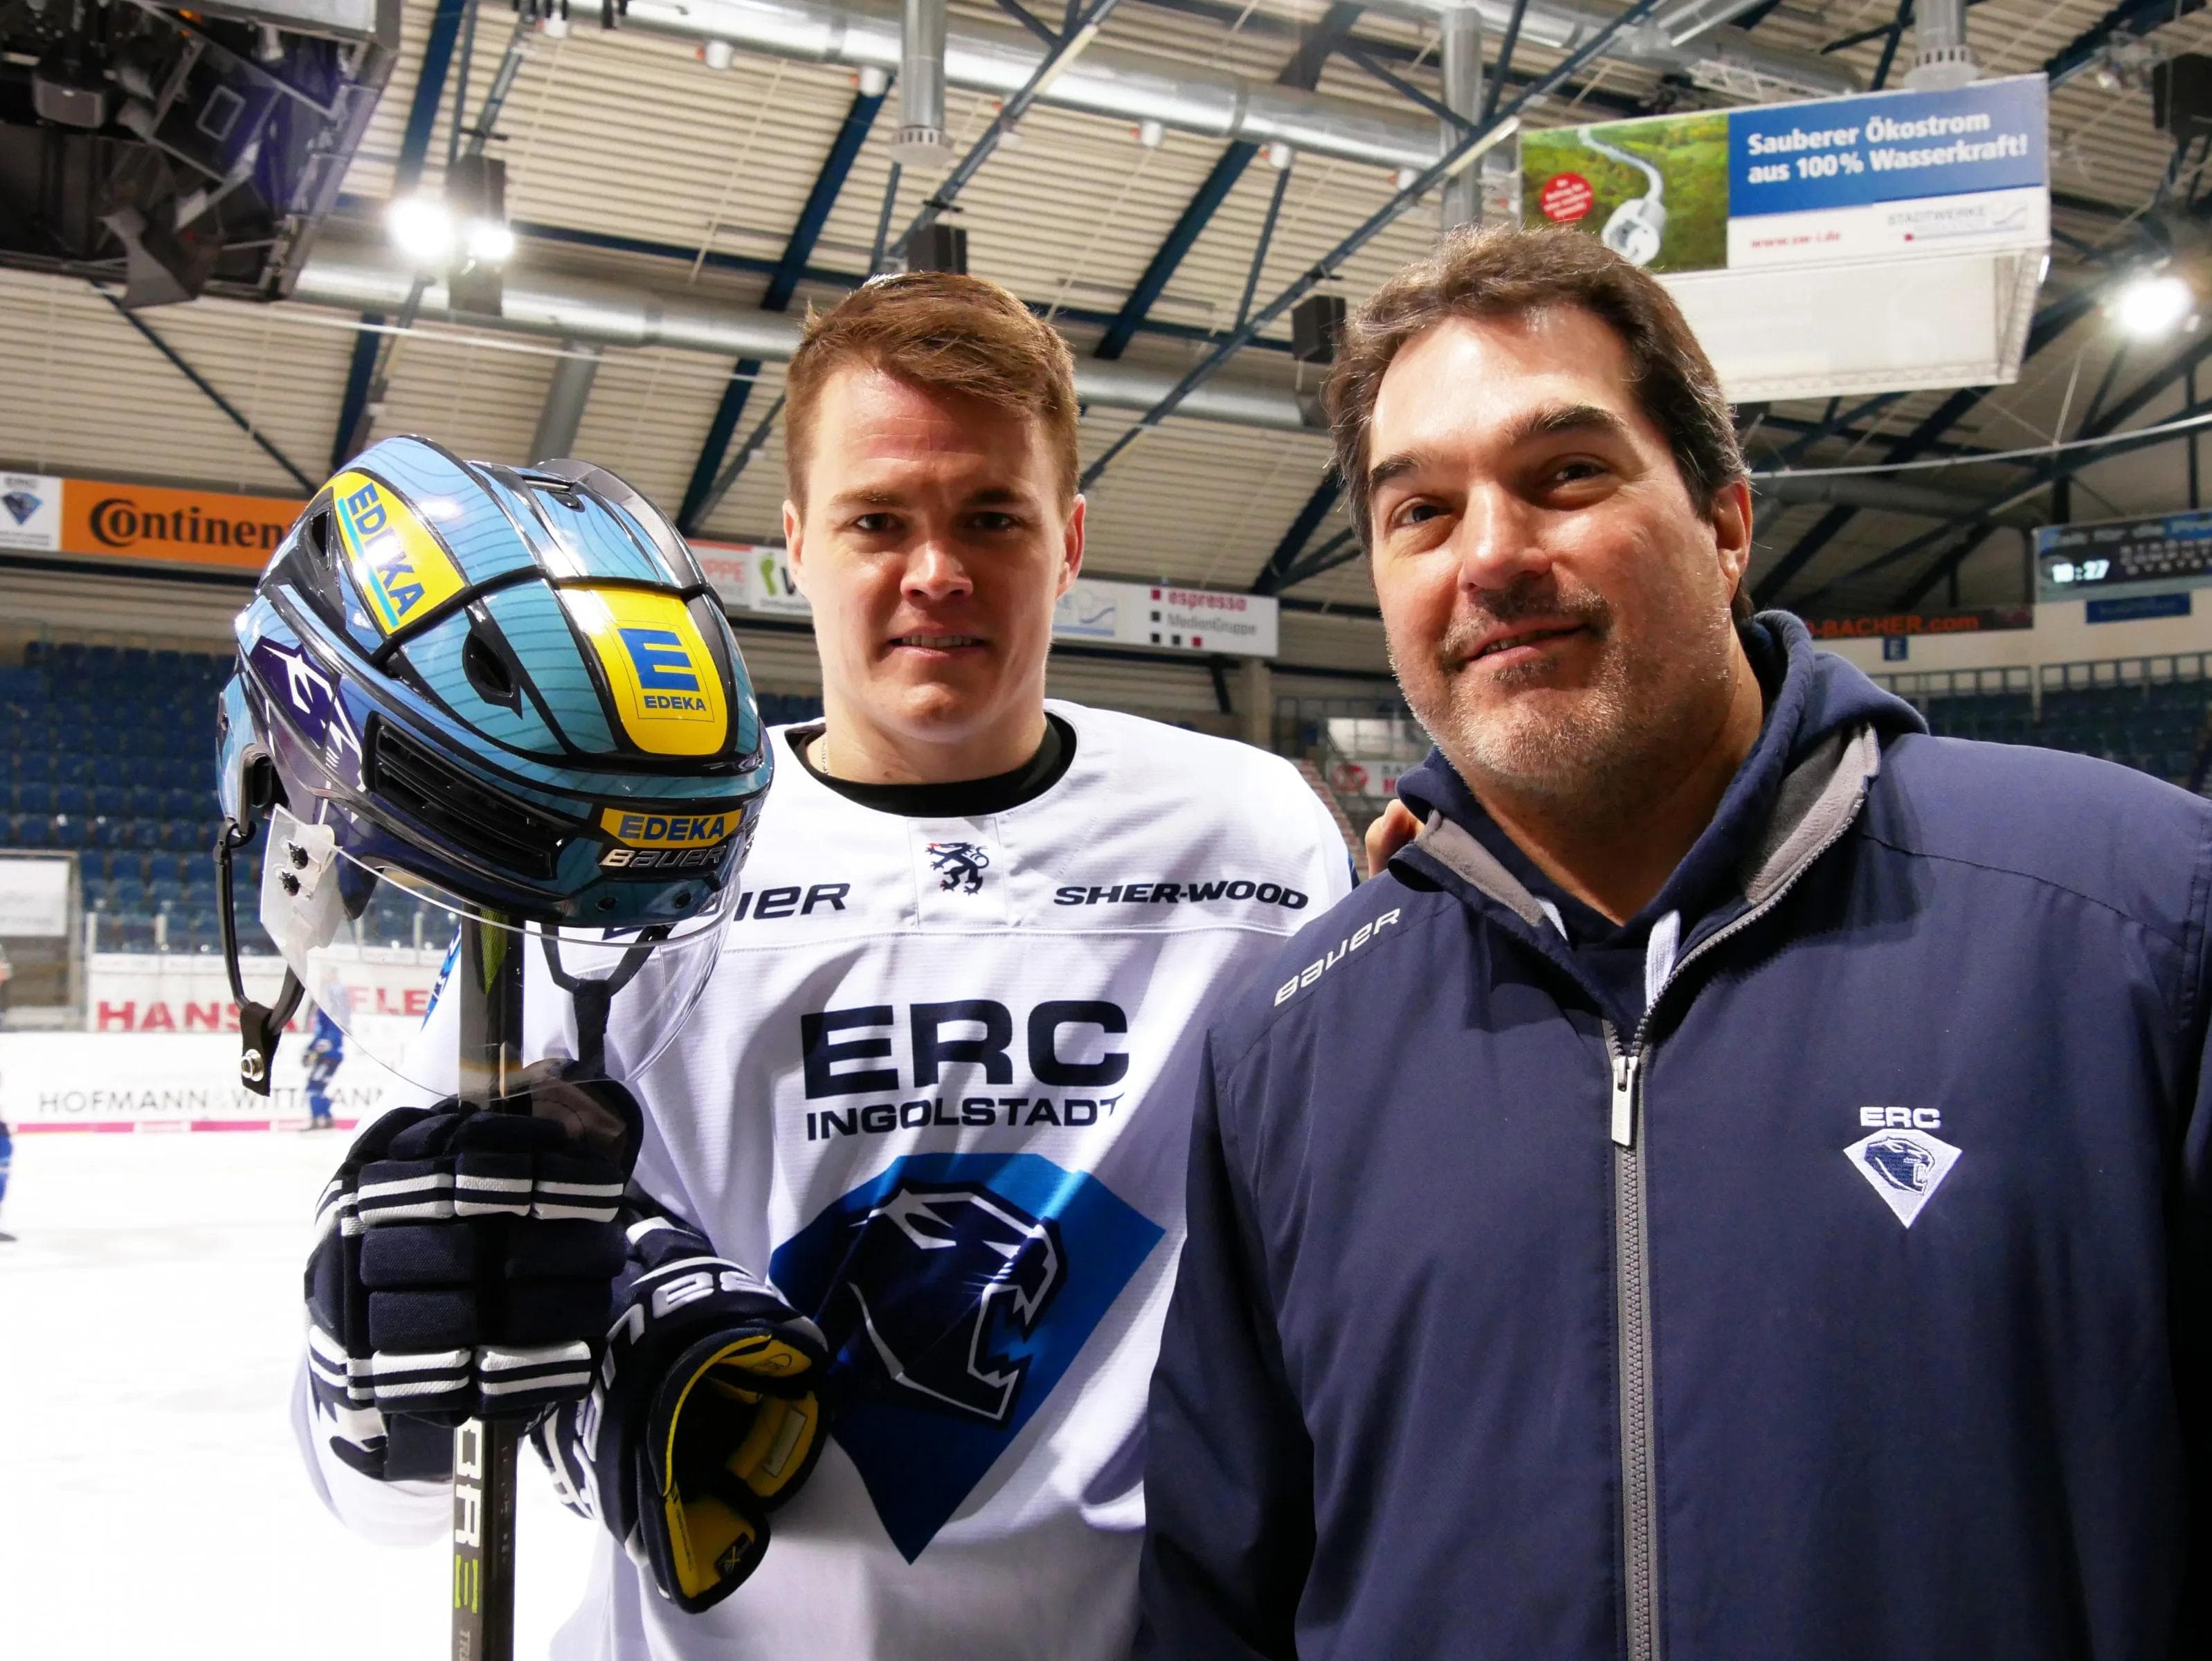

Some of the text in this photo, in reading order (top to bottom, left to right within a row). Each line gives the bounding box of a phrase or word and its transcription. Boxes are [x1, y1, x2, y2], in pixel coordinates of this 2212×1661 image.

[1748, 112, 1991, 156] Sauberer Ökostrom
[1748, 162, 1790, 184] aus
[1870, 133, 2029, 172] Wasserkraft!
[89, 498, 288, 550] Continen
[347, 482, 425, 617] EDKA
[1168, 590, 1247, 612] espresso
[617, 628, 700, 692] E
[644, 696, 707, 711] EDEKA
[618, 815, 725, 841] EDEKA
[1053, 880, 1309, 909] SHER-WOOD
[801, 999, 1130, 1100] ERC
[39, 1088, 206, 1114] HOFMANN
[1860, 1106, 1941, 1129] ERC
